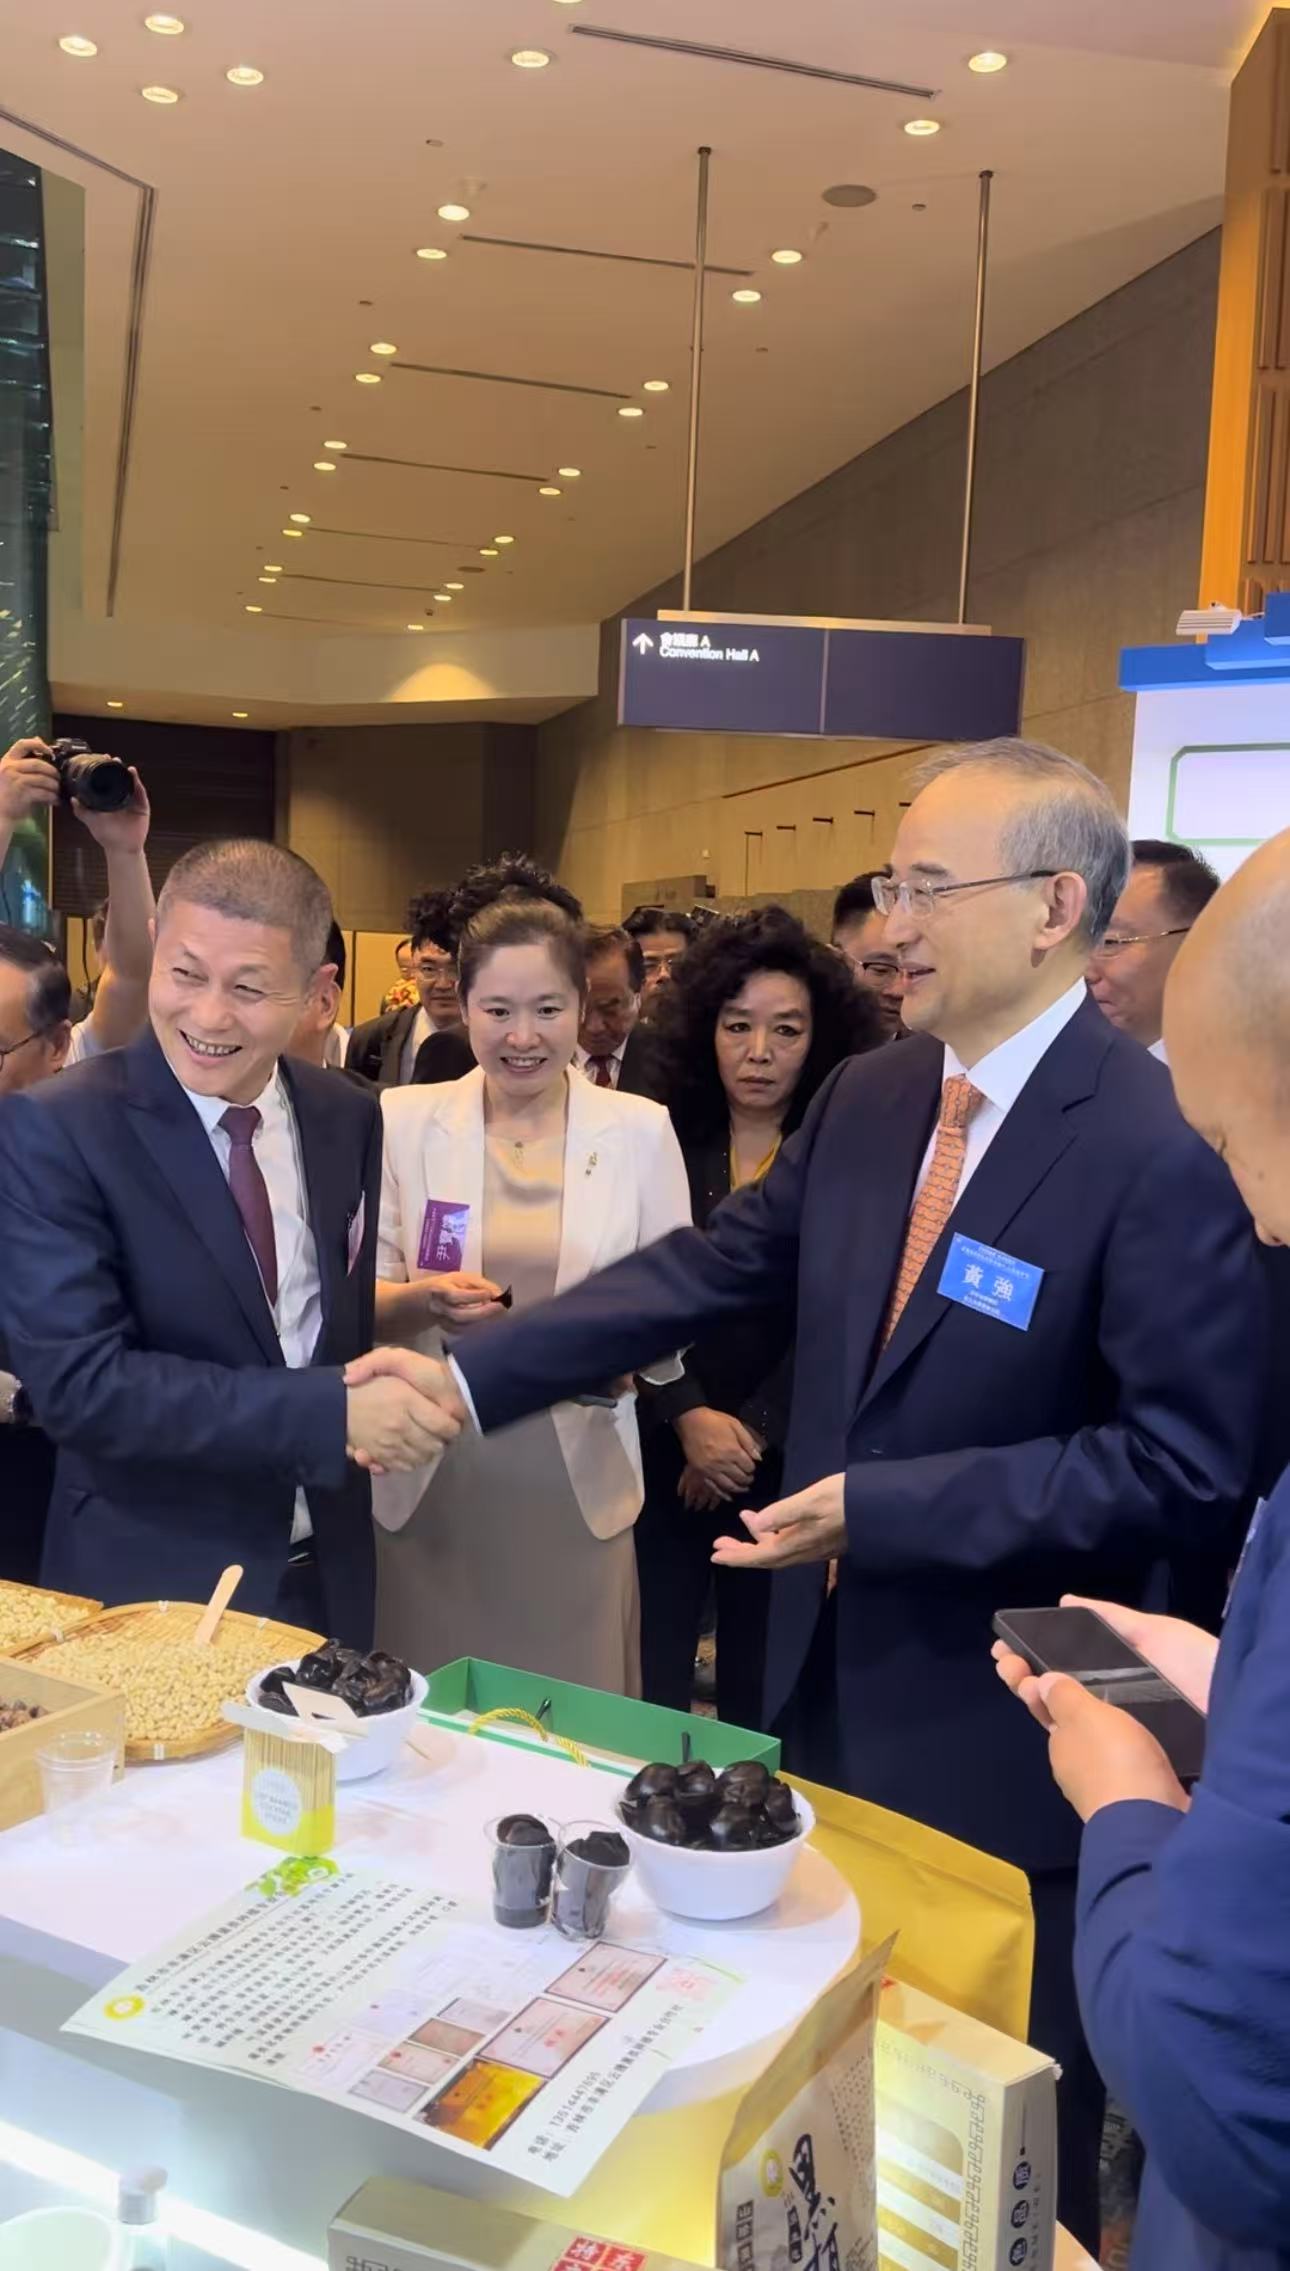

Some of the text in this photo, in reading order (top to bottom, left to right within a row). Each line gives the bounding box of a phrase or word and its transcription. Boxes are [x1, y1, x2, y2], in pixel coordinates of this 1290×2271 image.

[700, 635, 711, 649] A
[659, 648, 760, 662] Convention Hall A
